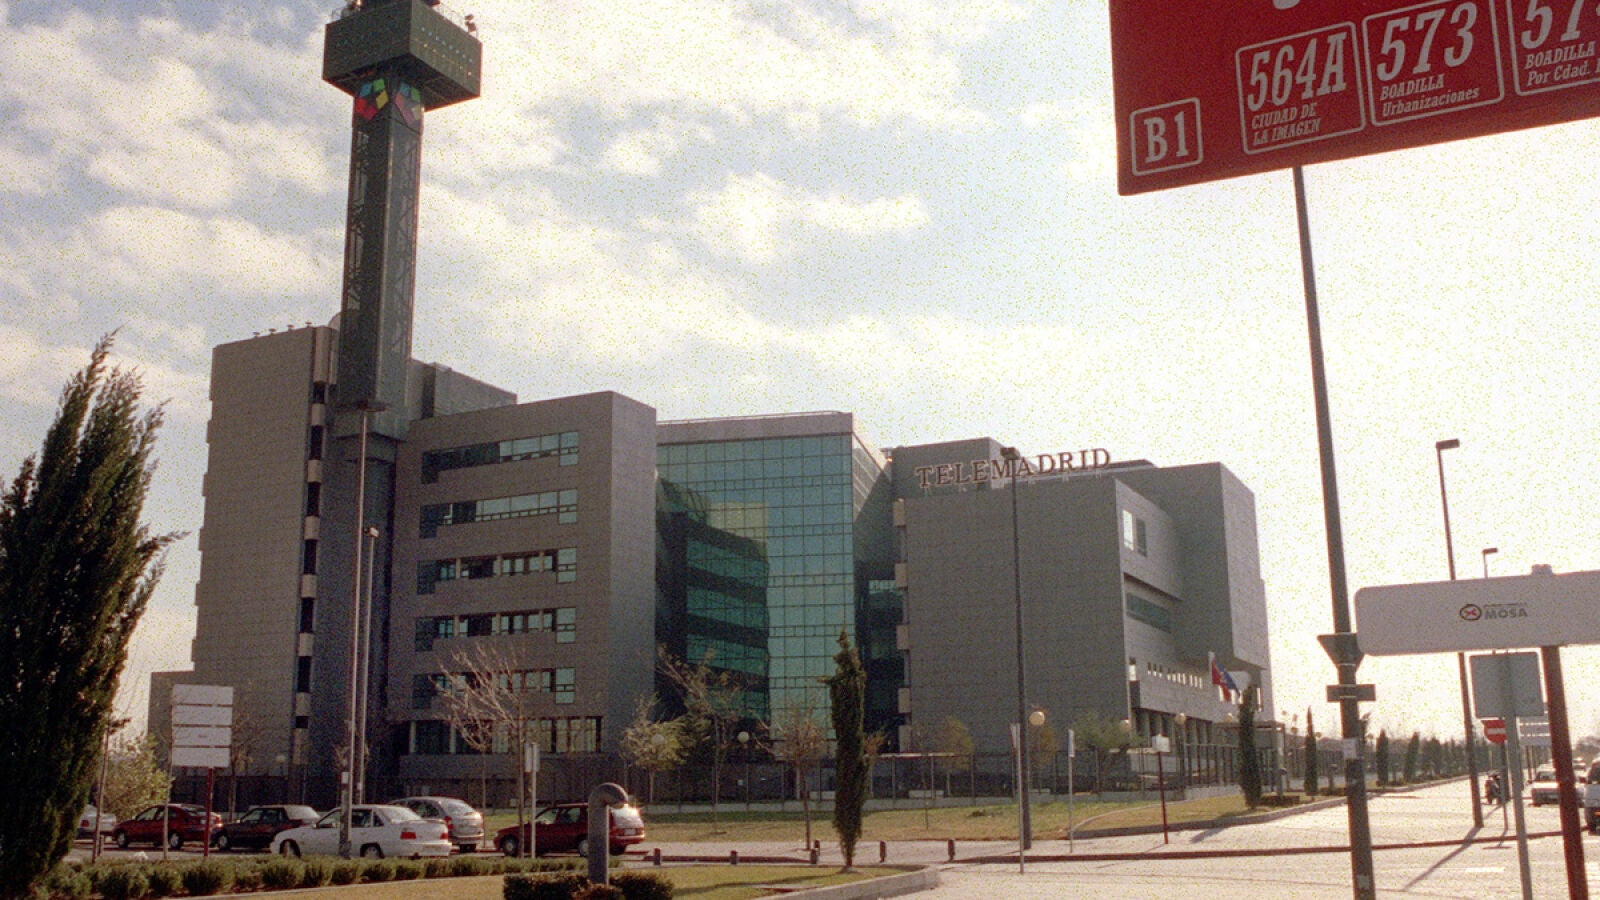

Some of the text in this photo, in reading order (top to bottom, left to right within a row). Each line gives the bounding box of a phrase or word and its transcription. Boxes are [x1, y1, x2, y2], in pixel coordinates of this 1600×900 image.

[1521, 0, 1600, 49] 57
[1376, 2, 1477, 81] 573
[1524, 41, 1596, 70] BOADILLA
[1247, 31, 1347, 111] 564A
[1527, 71, 1550, 87] Por
[1554, 60, 1590, 80] Cdad.
[1381, 74, 1444, 101] BOADILLA
[1382, 87, 1479, 117] Urbanizaciones
[1252, 102, 1318, 130] CIUDAD DE
[1143, 111, 1189, 163] B1
[1253, 118, 1321, 146] LA IMAGEN
[915, 448, 1111, 488] TELEMADRID
[1484, 608, 1528, 619] MOSA
